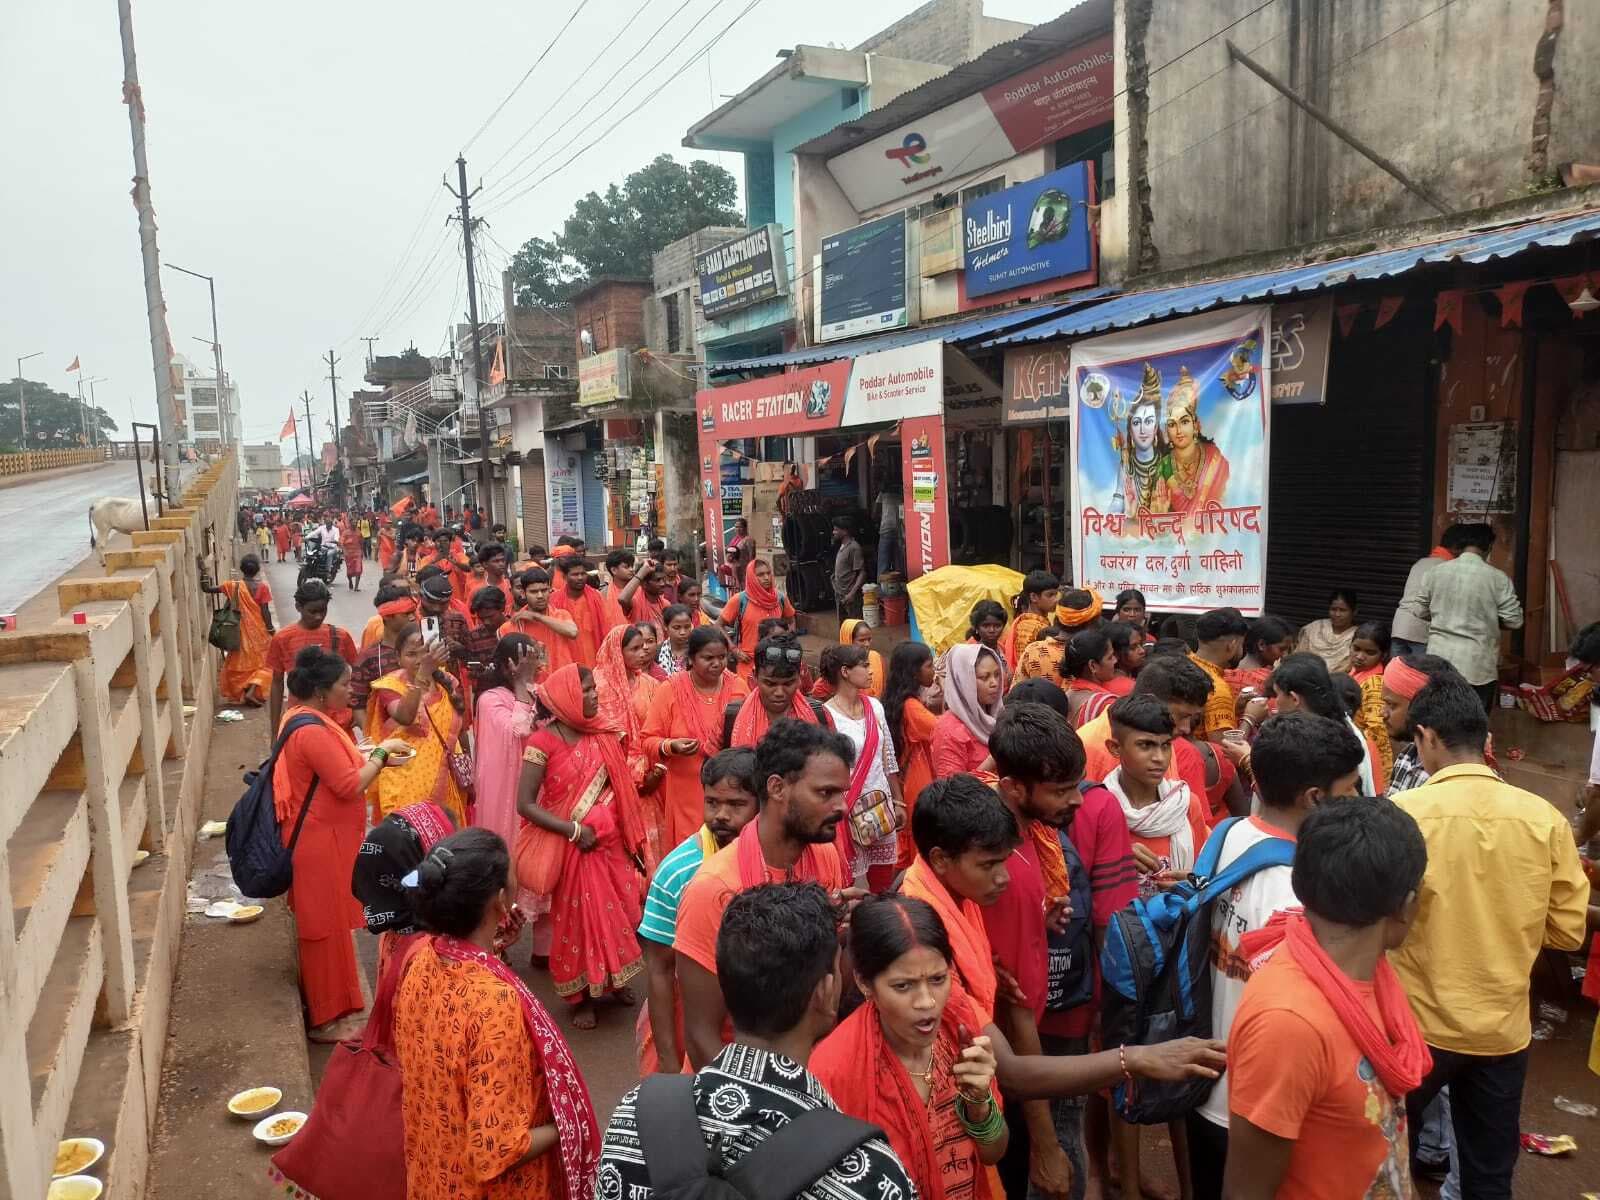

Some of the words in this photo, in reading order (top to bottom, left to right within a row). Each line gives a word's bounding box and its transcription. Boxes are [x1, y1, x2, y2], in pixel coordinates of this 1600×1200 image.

[1004, 82, 1041, 102] Poddar
[1043, 51, 1114, 87] Automobiles
[967, 203, 1011, 248] Steelbird
[705, 250, 723, 275] SAAD
[721, 230, 768, 269] ELECTRONICS
[988, 271, 1007, 283] SUMIT
[1008, 260, 1051, 277] AUTOMOTIVE
[859, 375, 886, 391] Poddar
[887, 366, 934, 386] Automobile
[883, 388, 904, 400] Scooter
[905, 384, 926, 396] Service
[722, 400, 753, 423] RACER
[756, 391, 804, 419] STATION
[1082, 506, 1127, 537] विश्व
[1138, 506, 1187, 546] हिन्दू
[1194, 500, 1262, 534] परिषद
[1199, 549, 1244, 573] वाहिनी
